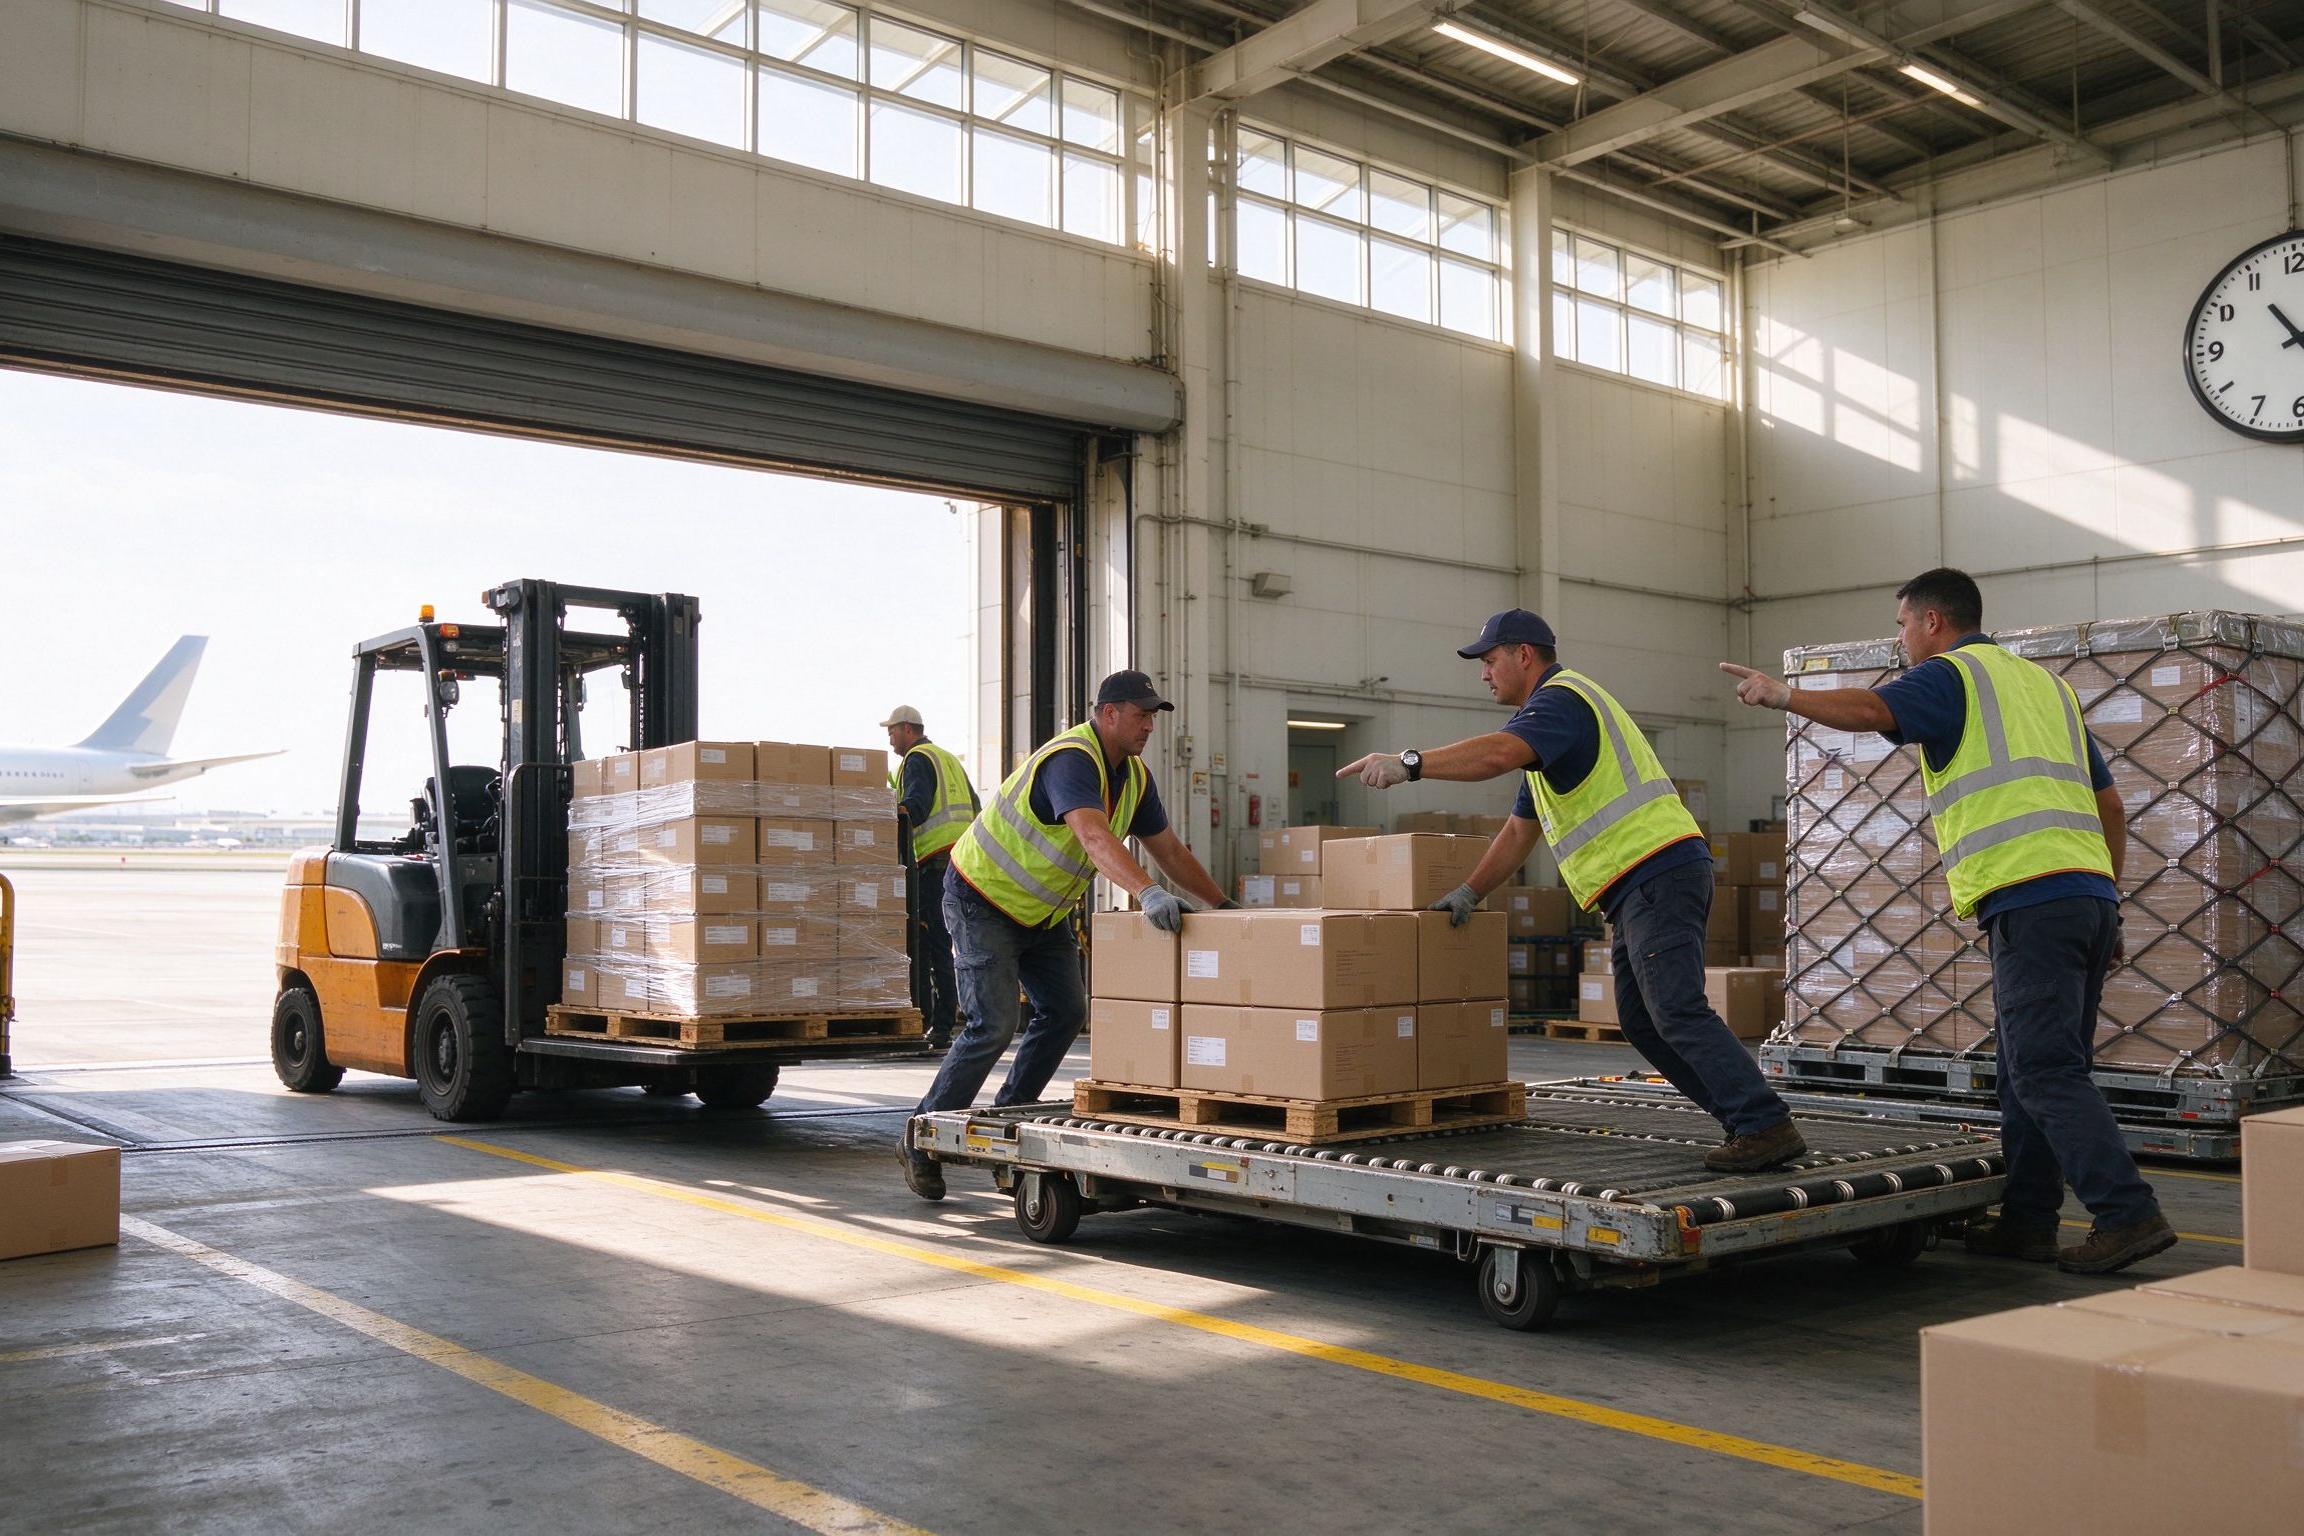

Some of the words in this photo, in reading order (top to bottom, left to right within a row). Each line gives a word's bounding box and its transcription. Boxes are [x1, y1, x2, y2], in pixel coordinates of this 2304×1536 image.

[2284, 252, 2304, 275] 12
[2249, 273, 2260, 291] 11
[2208, 341, 2224, 362] 9
[2251, 395, 2266, 416] 7
[2293, 396, 2304, 418] 6
